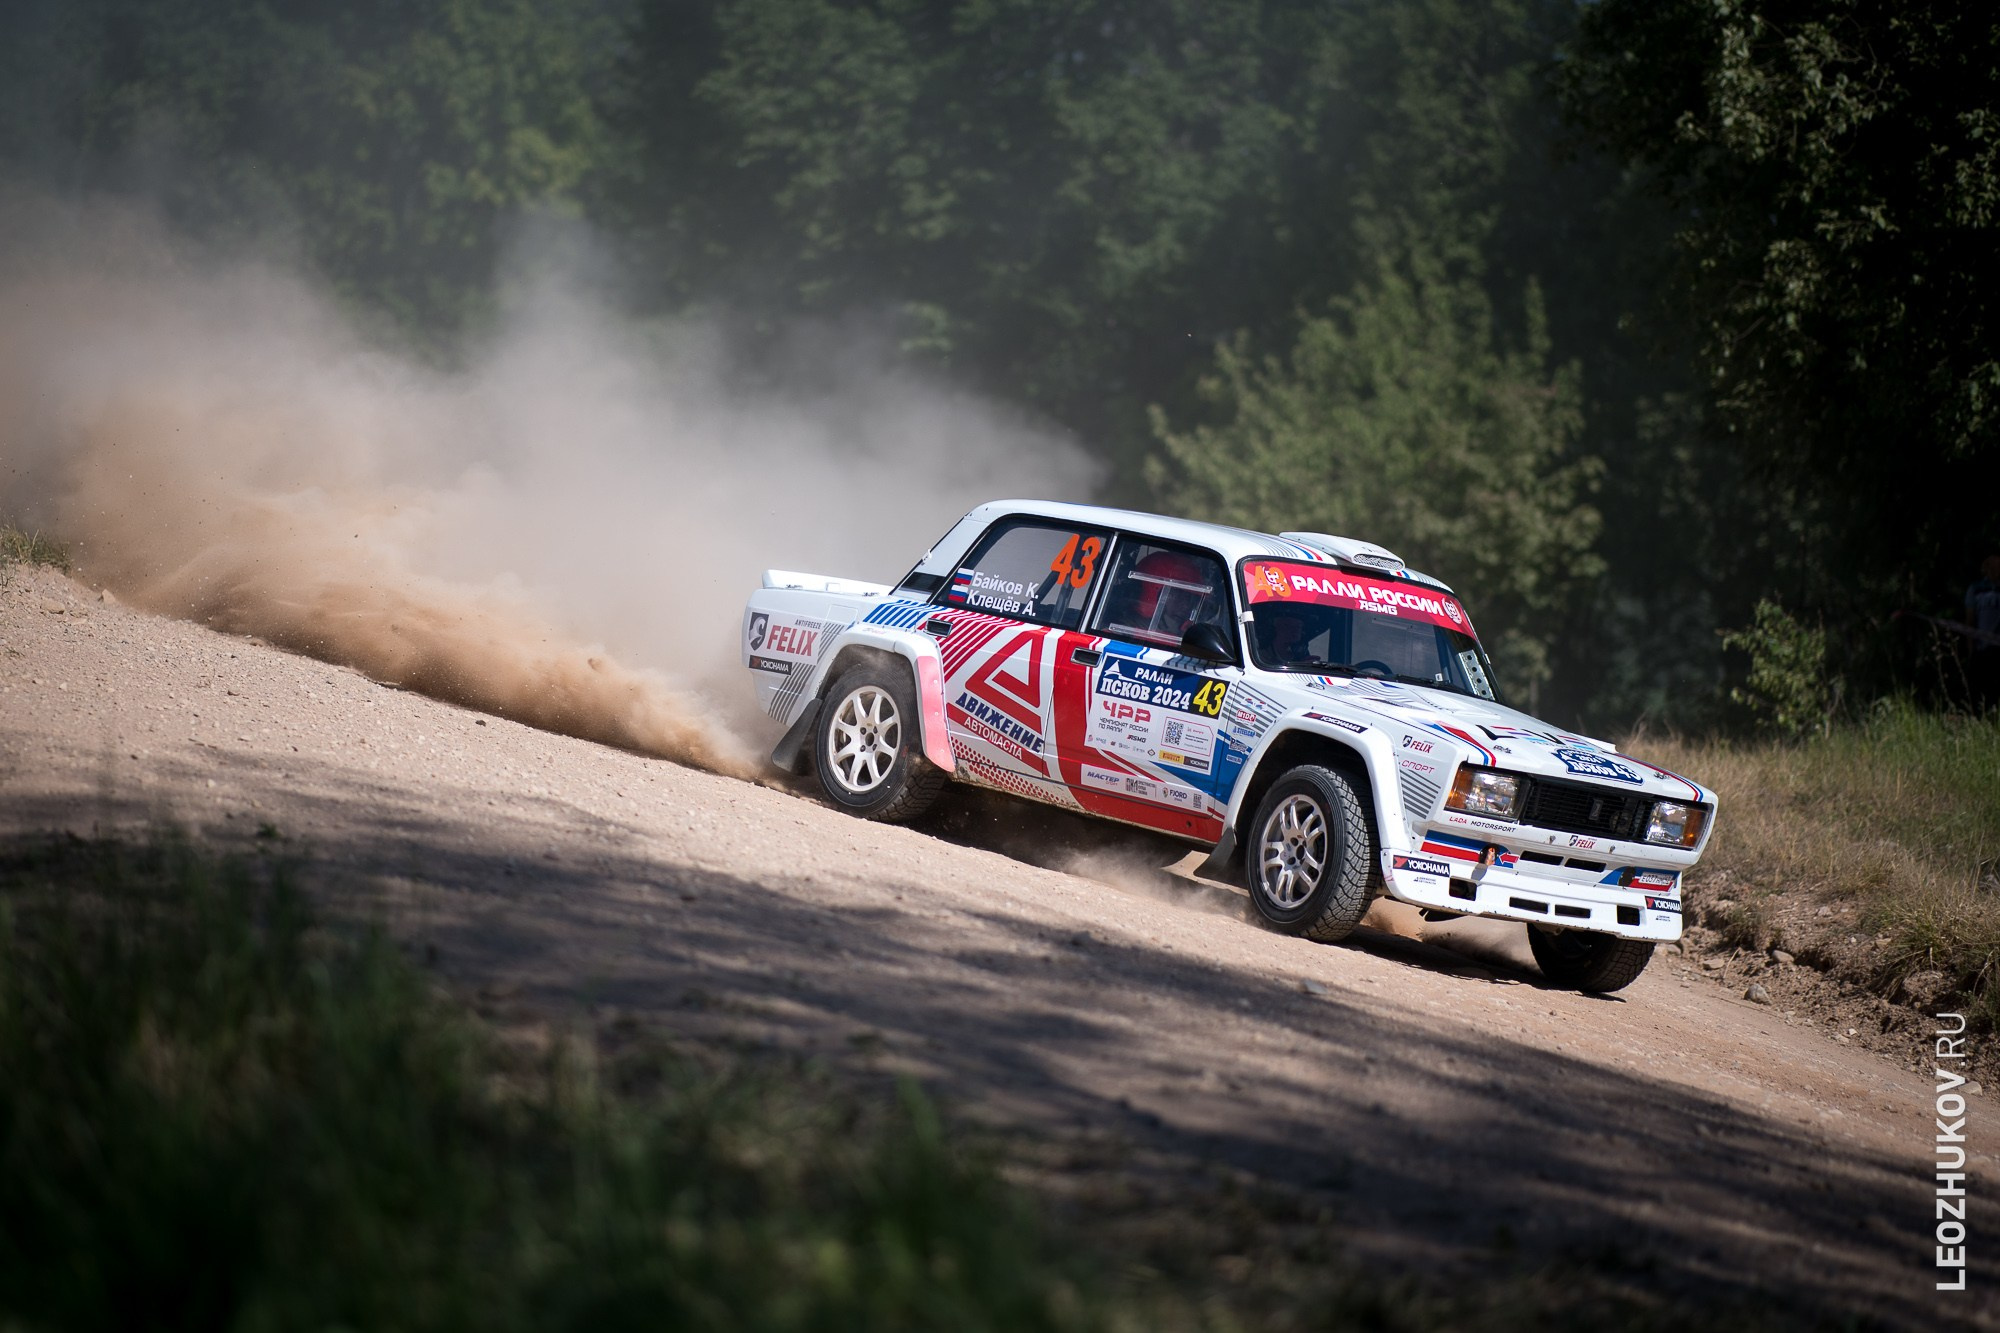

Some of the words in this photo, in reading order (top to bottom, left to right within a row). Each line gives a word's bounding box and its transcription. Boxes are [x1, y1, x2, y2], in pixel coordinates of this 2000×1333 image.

[1051, 534, 1101, 589] 43
[972, 572, 1023, 595] Байков
[1025, 582, 1040, 599] К.
[1253, 565, 1291, 598] 43
[966, 590, 1021, 613] Клещёв
[1022, 601, 1036, 617] А.
[1290, 575, 1366, 600] РАЛЛИ
[1368, 587, 1445, 617] РОССИИ
[795, 619, 822, 629] ANTIFREEZE
[766, 625, 818, 656] FELIX
[760, 660, 789, 672] YOKOHAMA
[1134, 667, 1174, 685] РАЛЛИ
[1100, 678, 1150, 701] ПСКОВ
[1152, 686, 1192, 710] 2024
[1193, 680, 1226, 715] 43
[1321, 716, 1361, 732] YOKOHAMA
[963, 717, 1023, 760] АВТОМАСЛА
[1410, 740, 1433, 754] FELIX
[1401, 759, 1435, 774] СПОРТ
[1612, 763, 1642, 780] 43
[1087, 771, 1120, 783] МАСТЕР
[1169, 789, 1188, 799] FJORD
[1449, 816, 1467, 825] LADA
[1470, 820, 1516, 833] MOTORSPORT
[1575, 840, 1596, 849] FELIX
[1407, 858, 1450, 875] YOKOHAMA
[1654, 899, 1682, 912] YOKOHAMA
